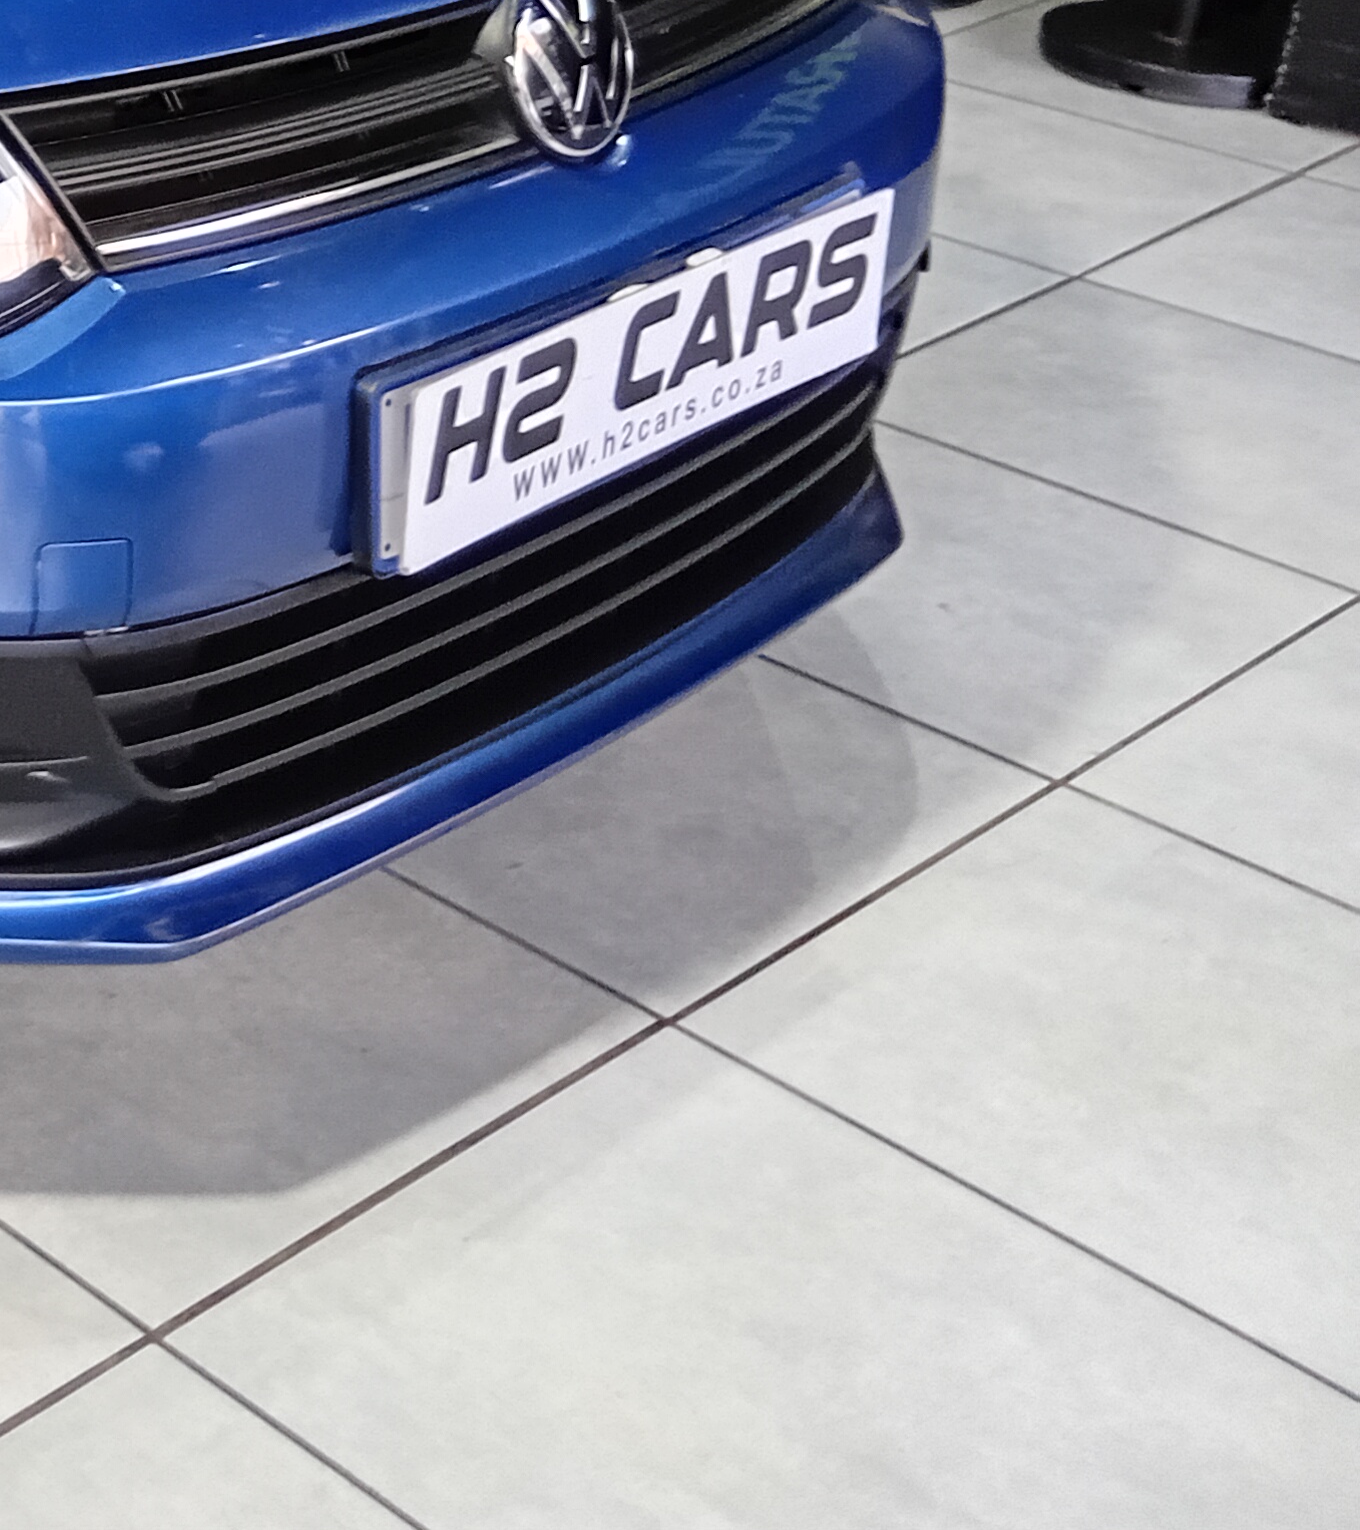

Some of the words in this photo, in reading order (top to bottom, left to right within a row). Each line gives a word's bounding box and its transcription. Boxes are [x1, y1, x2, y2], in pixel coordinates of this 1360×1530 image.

[424, 336, 578, 506] H2
[614, 212, 879, 411] CARS
[512, 358, 784, 502] www.h2cars.co.za
